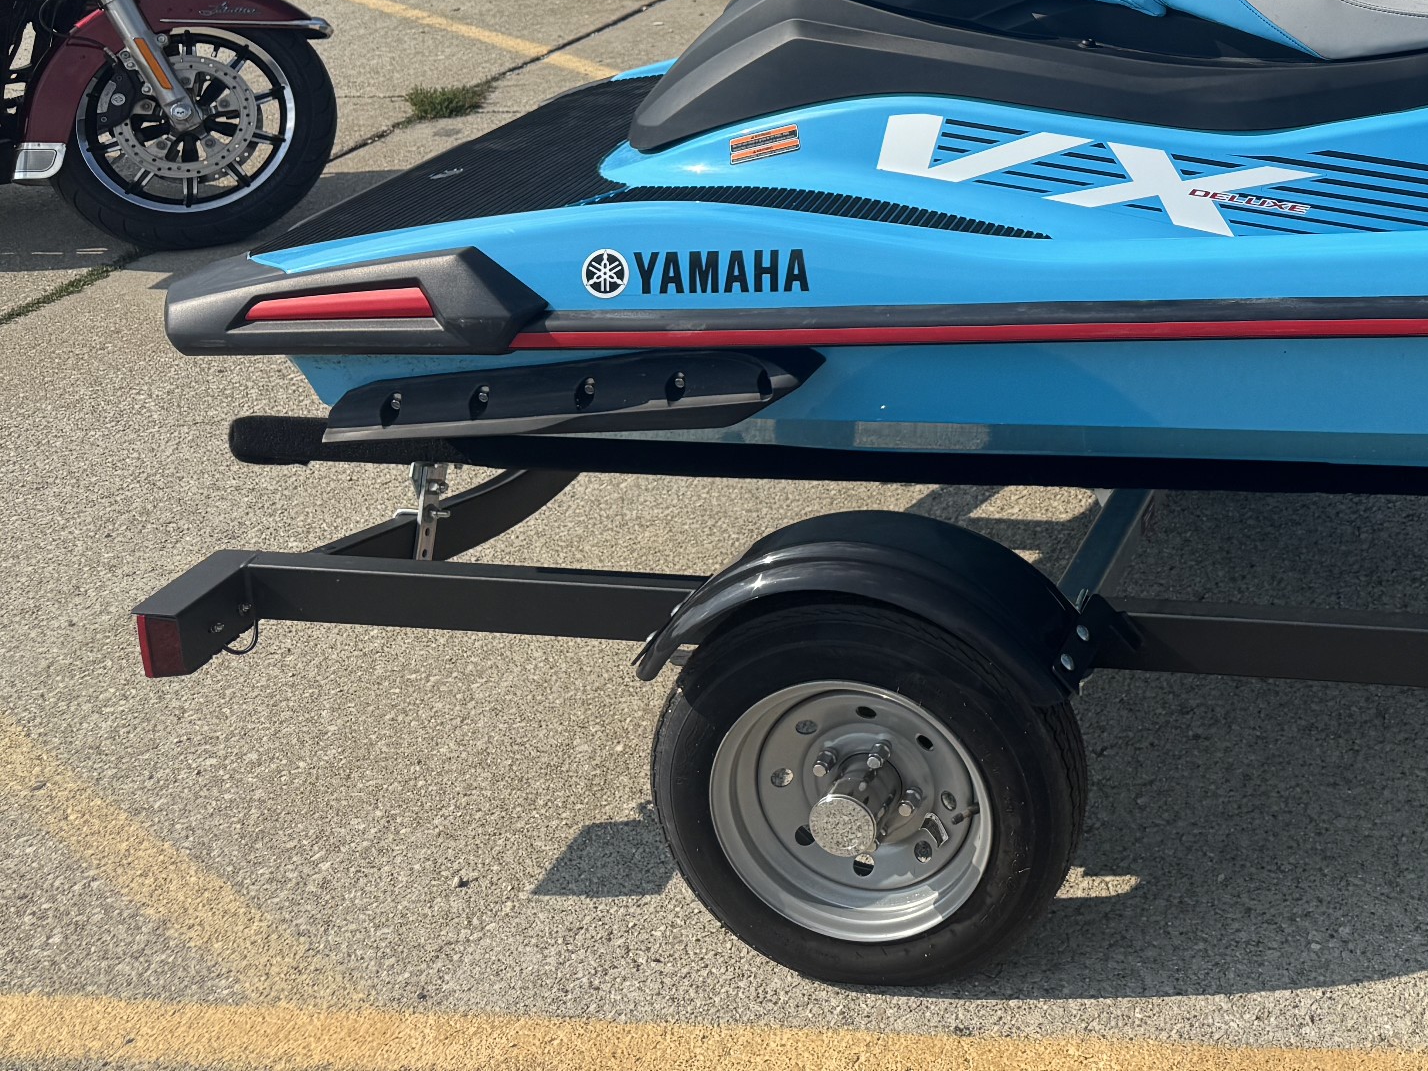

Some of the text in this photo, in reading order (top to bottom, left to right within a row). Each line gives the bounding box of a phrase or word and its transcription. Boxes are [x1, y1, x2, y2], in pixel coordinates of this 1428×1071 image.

[875, 113, 1323, 238] VX
[1188, 188, 1312, 215] DELUXE
[633, 248, 810, 295] YAMAHA
